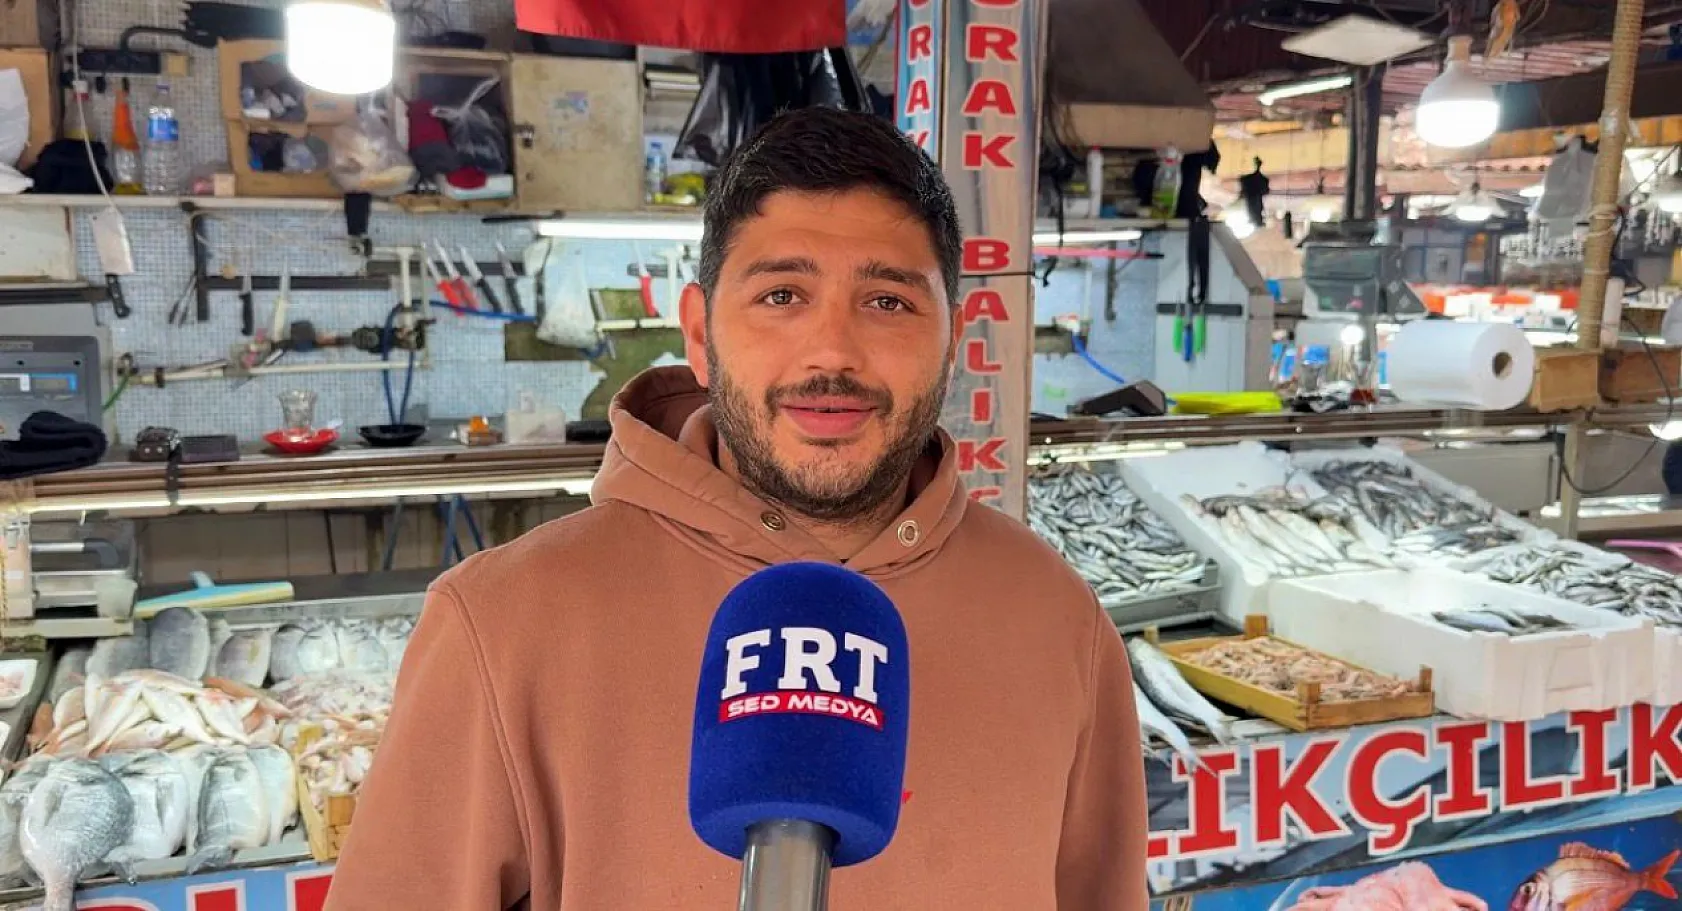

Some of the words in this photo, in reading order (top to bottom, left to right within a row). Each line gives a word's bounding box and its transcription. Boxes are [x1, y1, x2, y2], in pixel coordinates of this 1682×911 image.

[904, 0, 932, 148] RA
[963, 0, 1019, 169] RAK
[720, 627, 889, 704] FRT
[727, 694, 781, 718] SED
[787, 694, 879, 727] MEDYA
[1147, 700, 1682, 858] IKÇILIK
